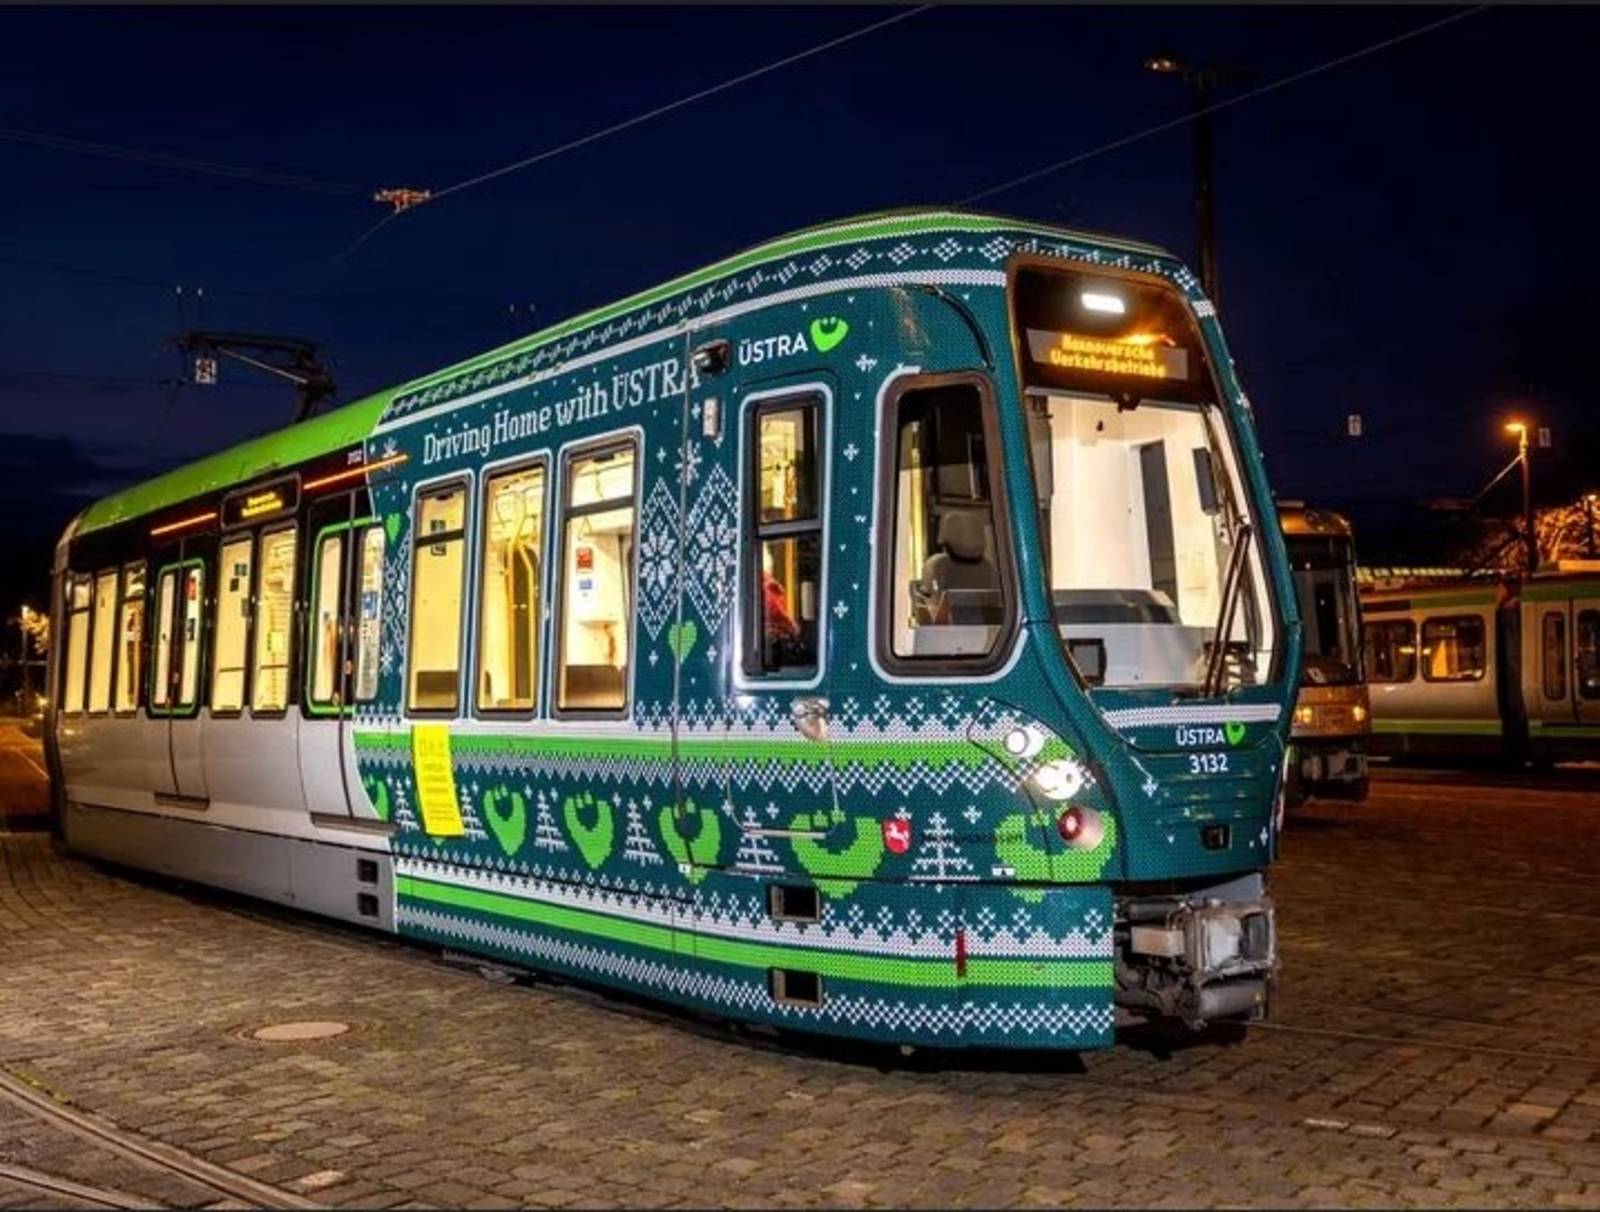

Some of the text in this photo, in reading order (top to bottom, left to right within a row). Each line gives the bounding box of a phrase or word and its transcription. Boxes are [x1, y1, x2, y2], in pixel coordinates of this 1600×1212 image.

[738, 331, 809, 366] ÜSTRA
[423, 354, 701, 465] Driving Home with ÜSTRA
[1175, 725, 1226, 746] ÜSTRA
[1189, 753, 1229, 774] 3132
